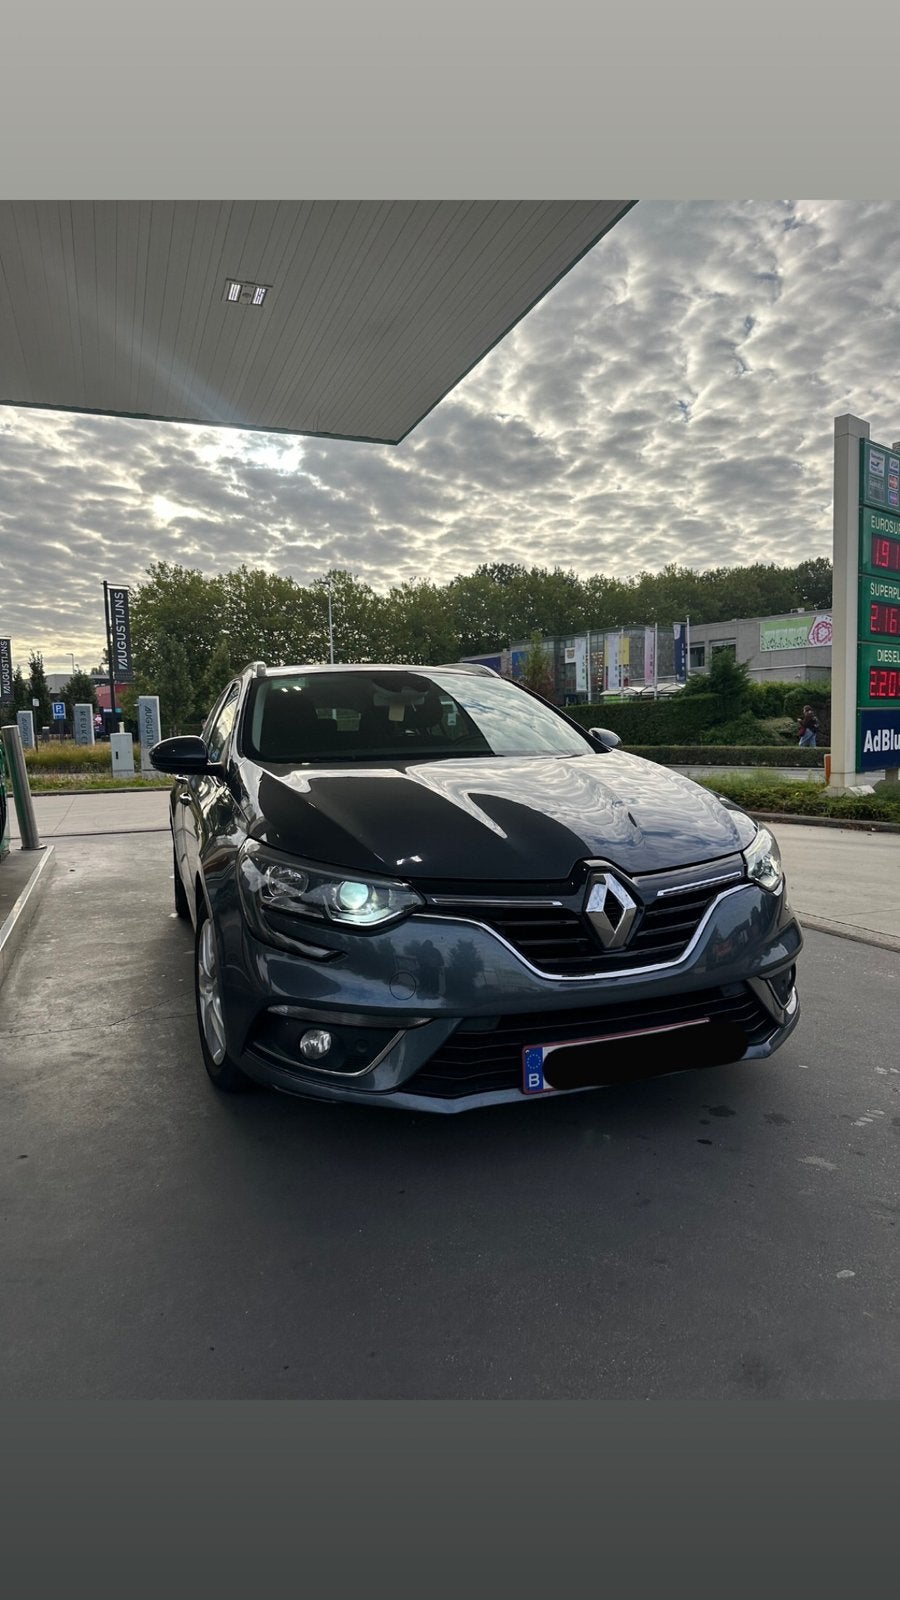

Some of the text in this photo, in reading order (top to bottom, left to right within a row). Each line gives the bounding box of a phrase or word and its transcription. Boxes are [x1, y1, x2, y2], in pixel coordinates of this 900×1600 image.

[114, 592, 128, 669] AUGUSTIJNS
[877, 649, 900, 663] DIESEL
[1, 640, 11, 694] AUGUSTIJNS
[55, 705, 62, 713] P
[528, 1073, 540, 1087] B
